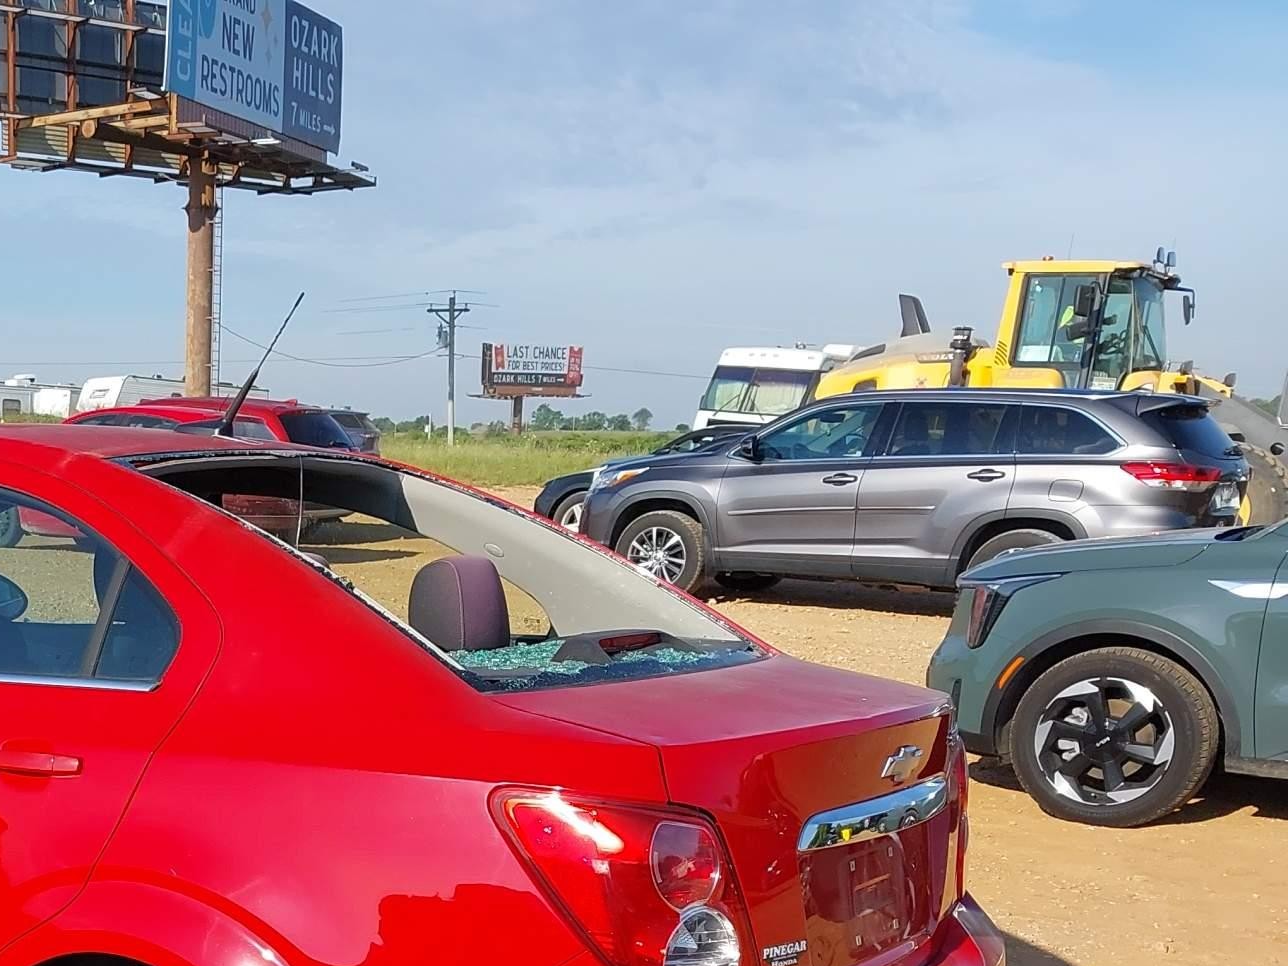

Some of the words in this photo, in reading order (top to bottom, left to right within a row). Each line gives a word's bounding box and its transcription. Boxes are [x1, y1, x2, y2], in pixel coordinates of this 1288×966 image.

[222, 11, 255, 62] NEW
[291, 15, 338, 67] OZARK
[200, 54, 280, 118] RESTROOMS
[292, 56, 335, 104] HILLS
[291, 102, 298, 126] 7
[299, 108, 321, 133] MILES
[507, 344, 530, 359] LAST
[532, 346, 567, 360] CHANCE
[507, 360, 520, 371] FOR
[523, 361, 537, 371] BEST
[493, 374, 515, 383] OZARK
[517, 375, 536, 384] HILLS
[763, 940, 807, 959] PINEGAR
